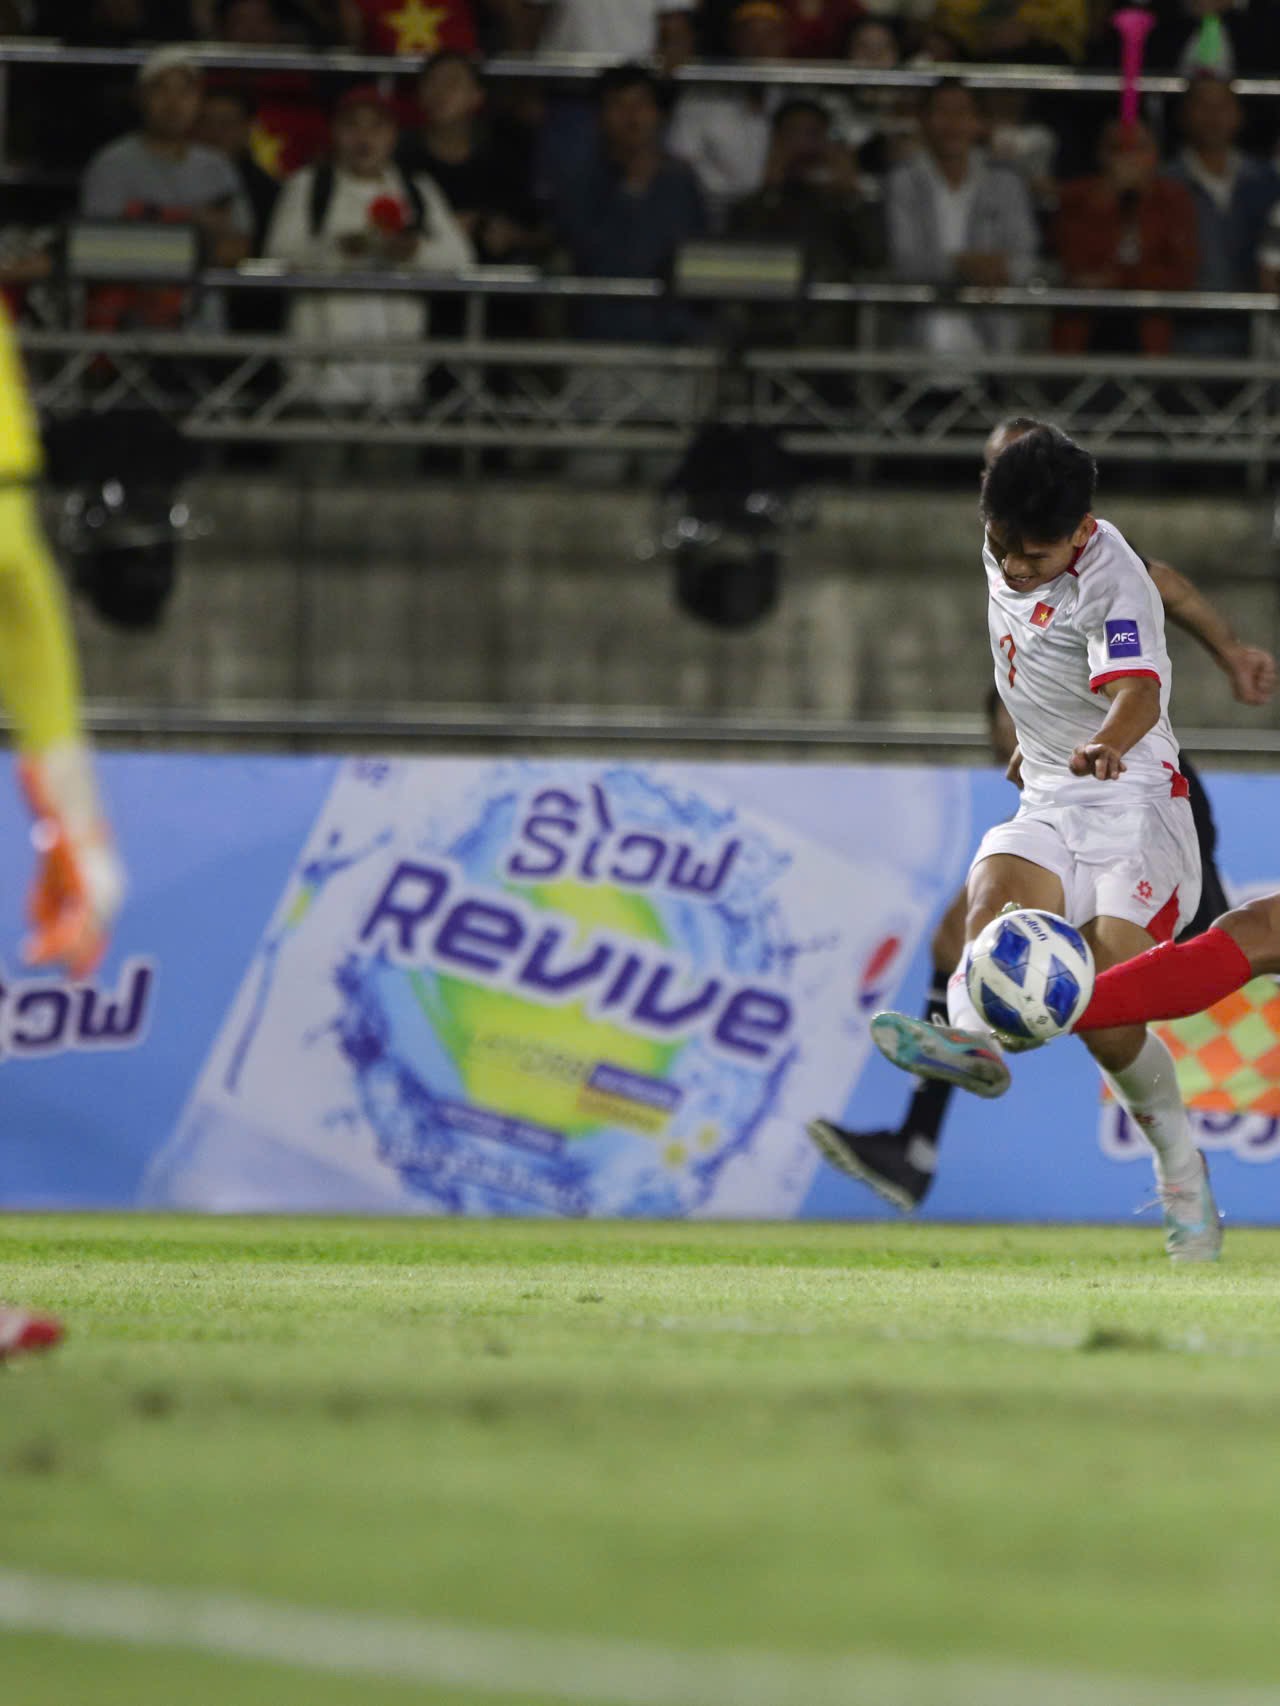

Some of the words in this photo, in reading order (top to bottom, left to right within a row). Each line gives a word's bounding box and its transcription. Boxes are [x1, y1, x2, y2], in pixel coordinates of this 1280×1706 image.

[999, 633, 1017, 689] 7
[1110, 632, 1137, 644] AFC
[358, 859, 792, 1060] Revive
